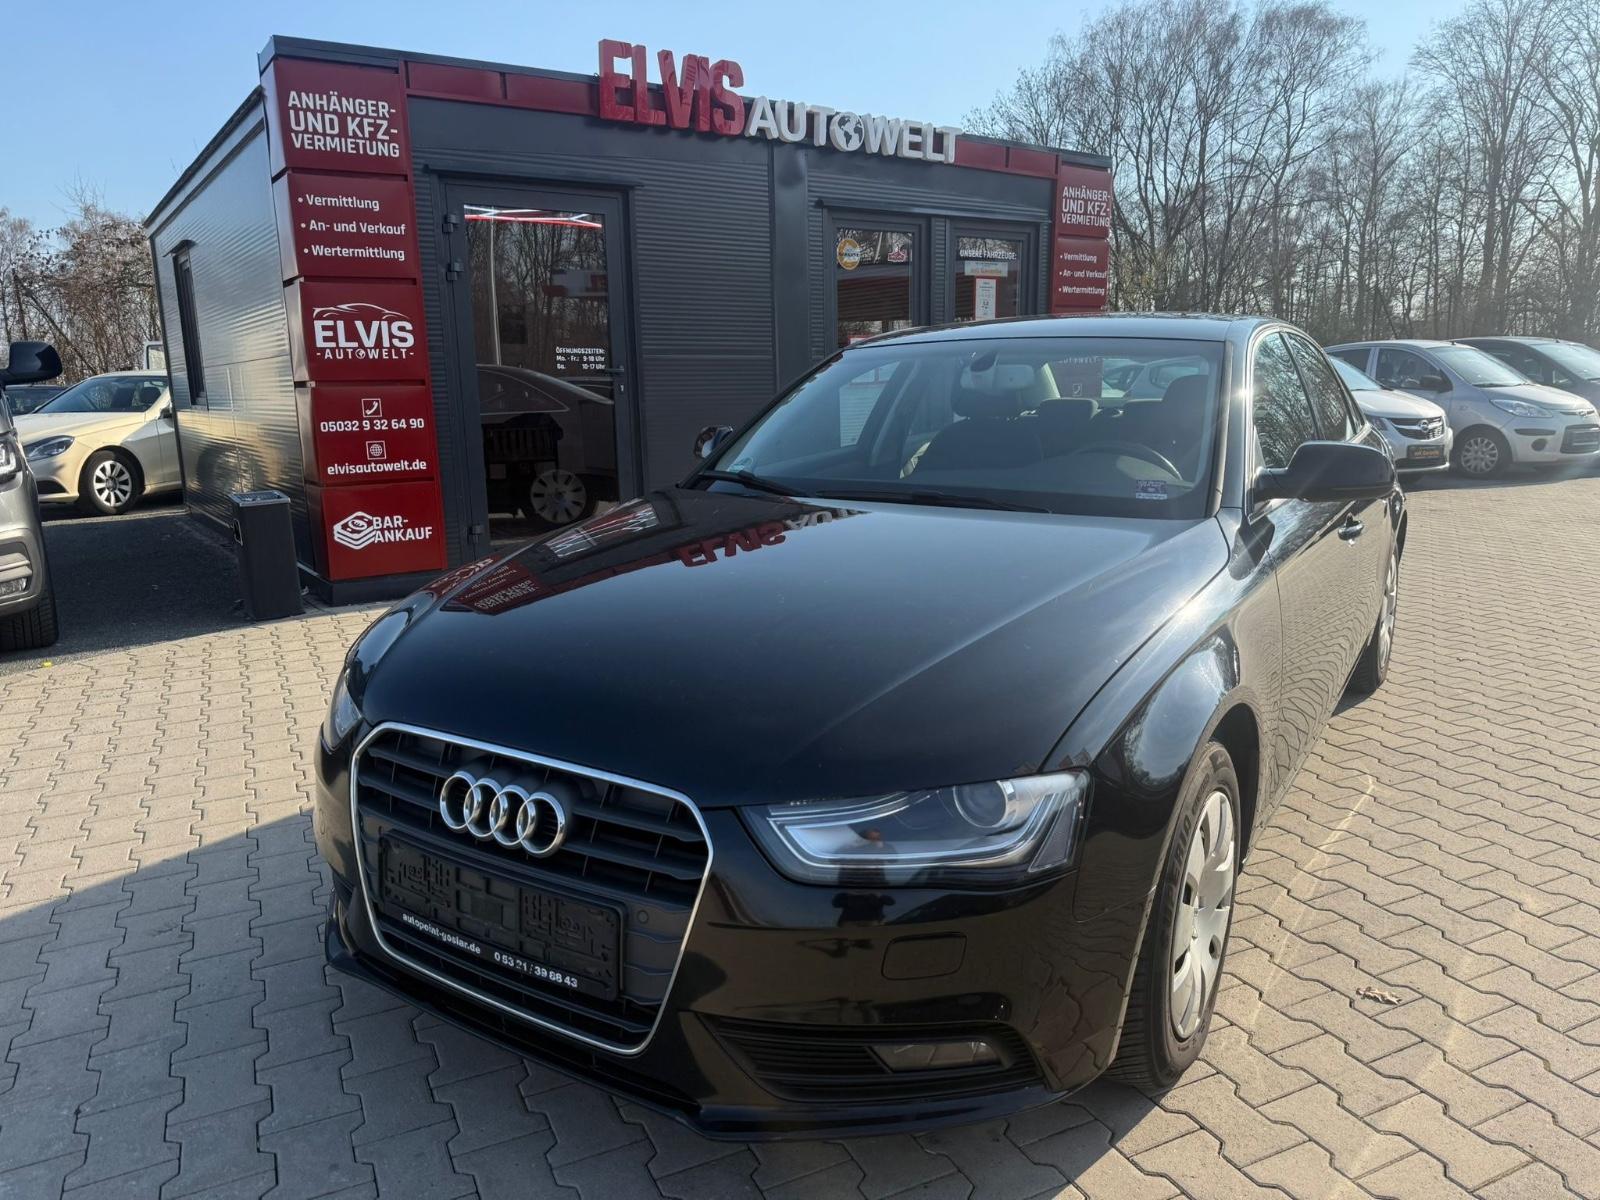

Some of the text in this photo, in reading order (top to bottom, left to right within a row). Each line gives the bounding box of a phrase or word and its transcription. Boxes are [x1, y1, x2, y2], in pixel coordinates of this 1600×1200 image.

[288, 90, 396, 118] ANHÄNGER-
[598, 38, 961, 164] ELVIS AUTOWELT
[289, 110, 398, 140] UND KFZ-
[291, 132, 400, 157] VERMIETUNG
[1062, 185, 1111, 202] ANHÄNGER-
[306, 194, 380, 212] Vermittlung
[1062, 199, 1110, 216] UND KFZ-
[309, 219, 406, 235] An- und Verkauf
[1061, 213, 1110, 228] VERMIETUNG
[311, 244, 405, 262] Wertermittlung
[959, 249, 982, 258] UNSERE
[1063, 253, 1097, 264] Vermittlung
[1073, 270, 1085, 279] und
[1062, 286, 1105, 297] Wertermittlung
[313, 320, 415, 348] ELVIS
[320, 418, 425, 432] 05032 9 32 64 90
[327, 459, 427, 475] elvisautowelt.de
[372, 515, 408, 529] BAR-
[374, 526, 433, 543] ANKAUF
[402, 912, 481, 955] autopoint-goslar.de
[494, 951, 501, 962] 0
[502, 954, 515, 967] 53
[534, 965, 548, 978] 39
